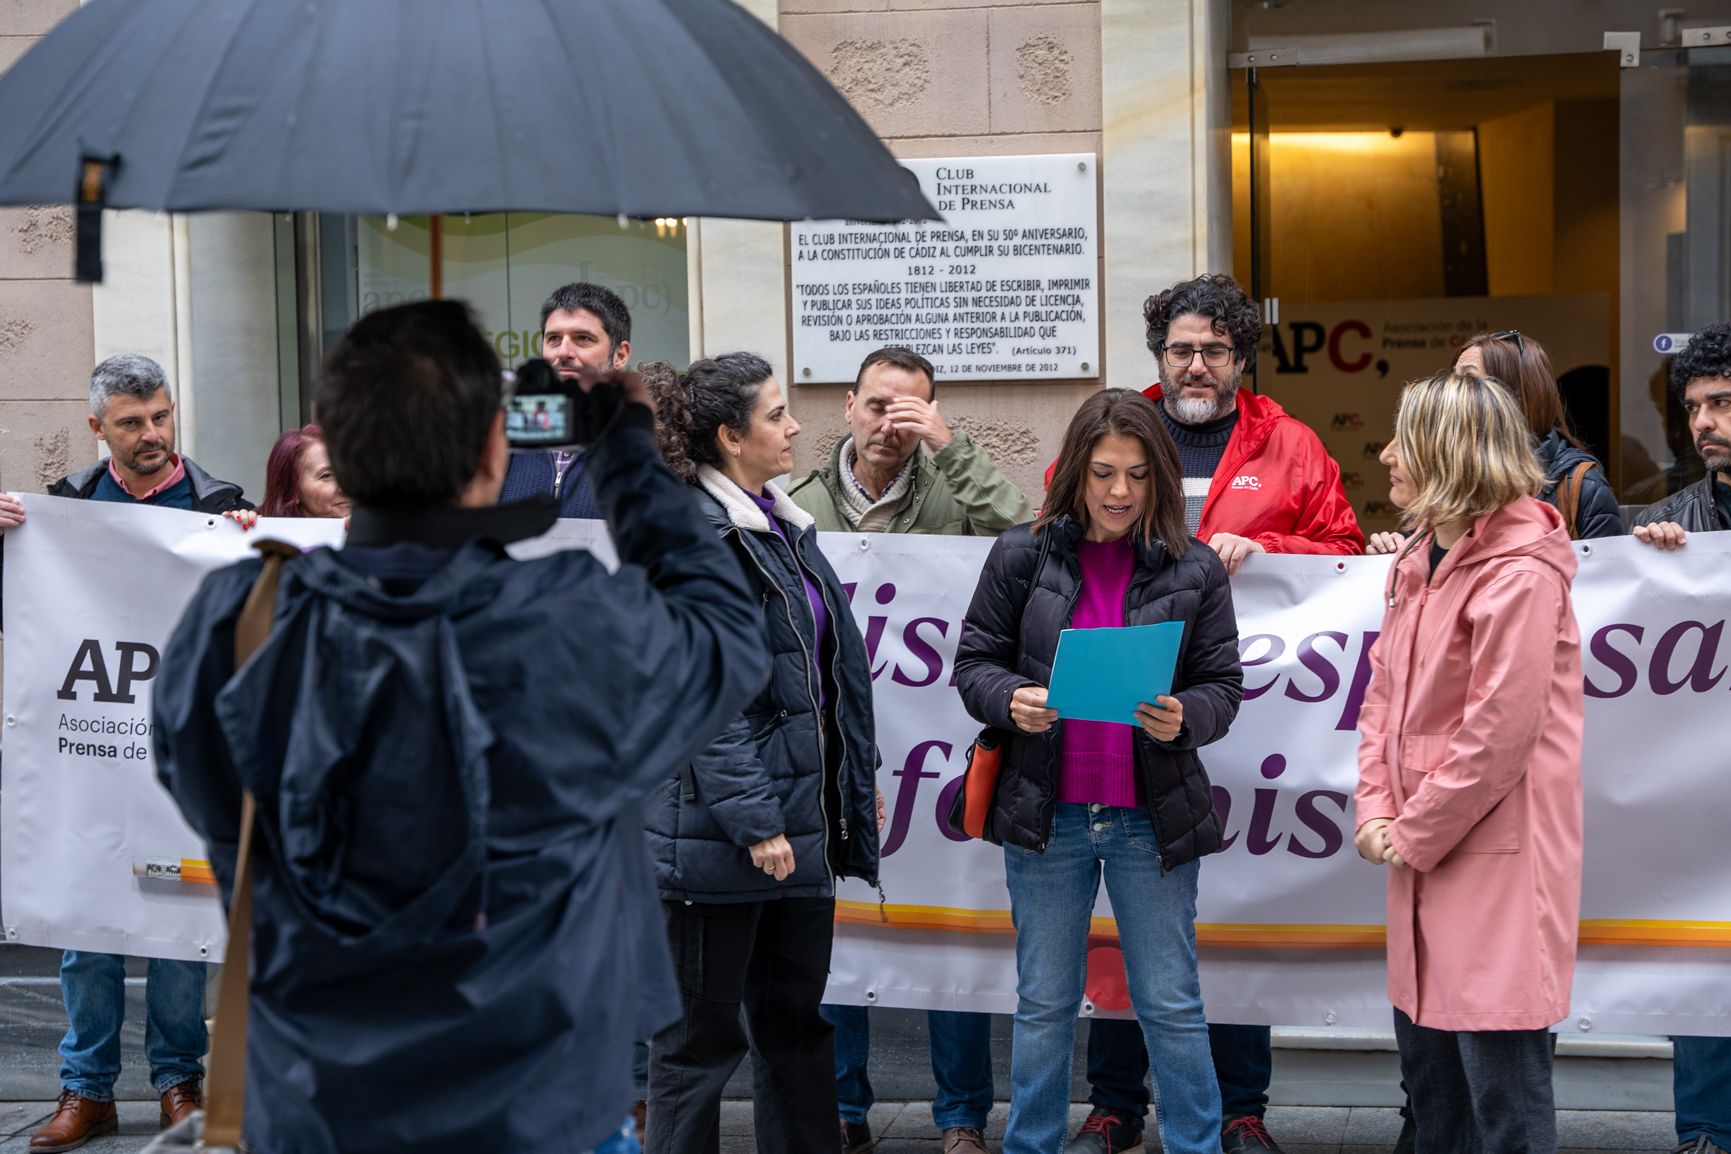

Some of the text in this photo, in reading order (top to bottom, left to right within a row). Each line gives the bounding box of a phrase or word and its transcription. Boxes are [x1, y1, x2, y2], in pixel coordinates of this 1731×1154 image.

[936, 167, 974, 180] CLUB
[937, 182, 1051, 196] INTERNACIONAL
[938, 197, 1015, 211] DE PRENSA
[798, 234, 809, 246] EL
[812, 233, 835, 246] CLUB
[838, 232, 912, 245] INTERNACIONAL
[915, 231, 927, 243] DE
[930, 230, 969, 244] PRENSA,
[972, 230, 984, 242] EN
[987, 229, 999, 241] SU
[1021, 227, 1088, 241] ANIVERSARIO,
[798, 249, 804, 261] A
[808, 249, 818, 261] LA
[821, 244, 890, 261] CONSTITUCIÓN
[893, 247, 906, 259] DE
[908, 244, 937, 259] CÁDIZ
[940, 246, 951, 258] AL
[954, 245, 994, 258] CUMPLIR
[997, 244, 1009, 257] SU
[908, 265, 935, 276] 1812
[948, 264, 976, 275] 2012
[832, 283, 849, 296] LOS
[852, 280, 901, 295] ESPAÑOLES
[904, 281, 936, 294] TIENEN
[940, 280, 982, 293] LIBERTAD
[986, 280, 997, 292] DE
[1000, 279, 1044, 293] ESCRIBIR,
[1048, 278, 1091, 291] IMPRIMIR
[802, 294, 1084, 311] Y PUBLICAR SUS IDEAS POLÍTICAS SIN NECESIDAD DE LICENCIA,
[801, 307, 1086, 326] REVISIÓN O APROBACIÓN ALGUNA ANTERIOR A LA PUBLICACIÓN,
[829, 326, 1057, 342] BAJO LAS RESTRICCIONES Y RESPONSABILIDAD QUE
[884, 343, 944, 355] BLEZCAN
[947, 343, 963, 355] LAS
[1055, 346, 1077, 356] 371)
[950, 366, 959, 374] 12
[962, 365, 972, 373] DE
[975, 363, 1022, 373] NOVIEMBRE
[1025, 363, 1036, 372] DE
[1039, 363, 1059, 372] 2012
[58, 737, 147, 760] Prensa de
